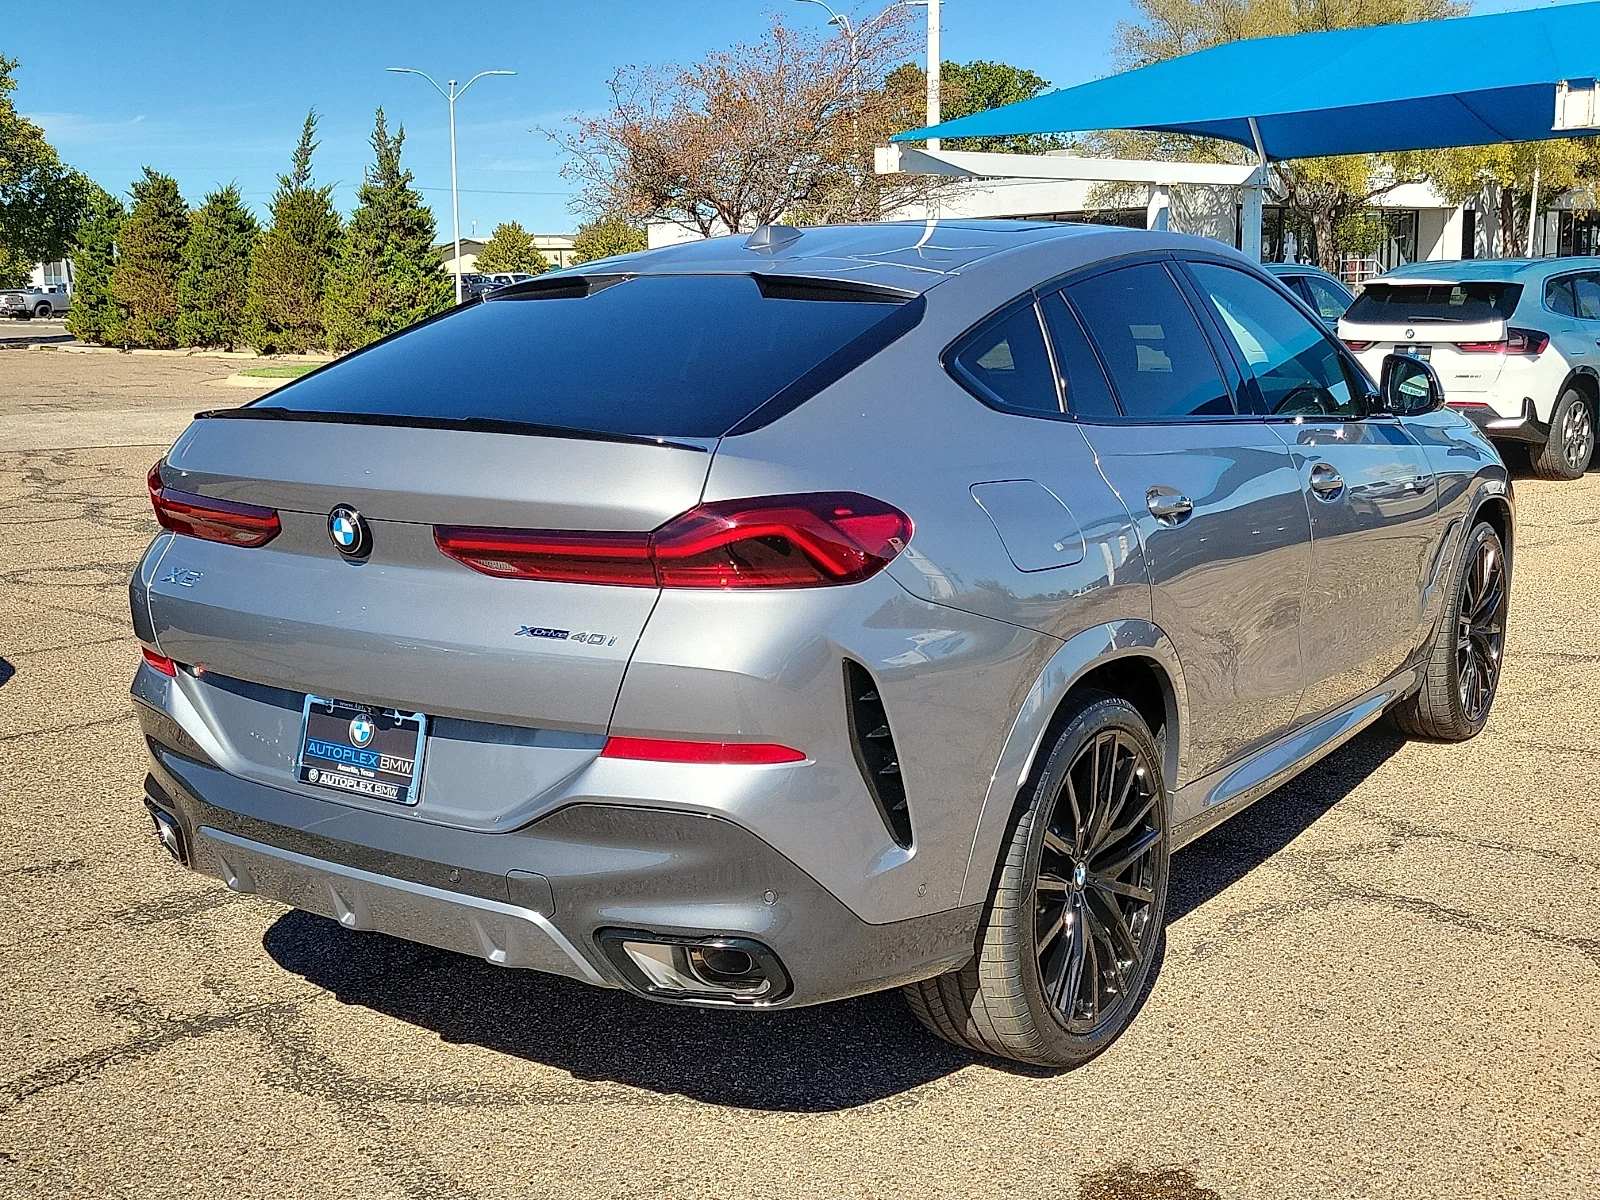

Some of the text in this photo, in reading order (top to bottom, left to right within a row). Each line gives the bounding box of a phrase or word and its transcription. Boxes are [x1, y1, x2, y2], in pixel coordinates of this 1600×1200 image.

[307, 742, 414, 774] AUTOPLEX BMW
[319, 773, 373, 792] AUTOPLEX
[374, 784, 398, 797] BMW
